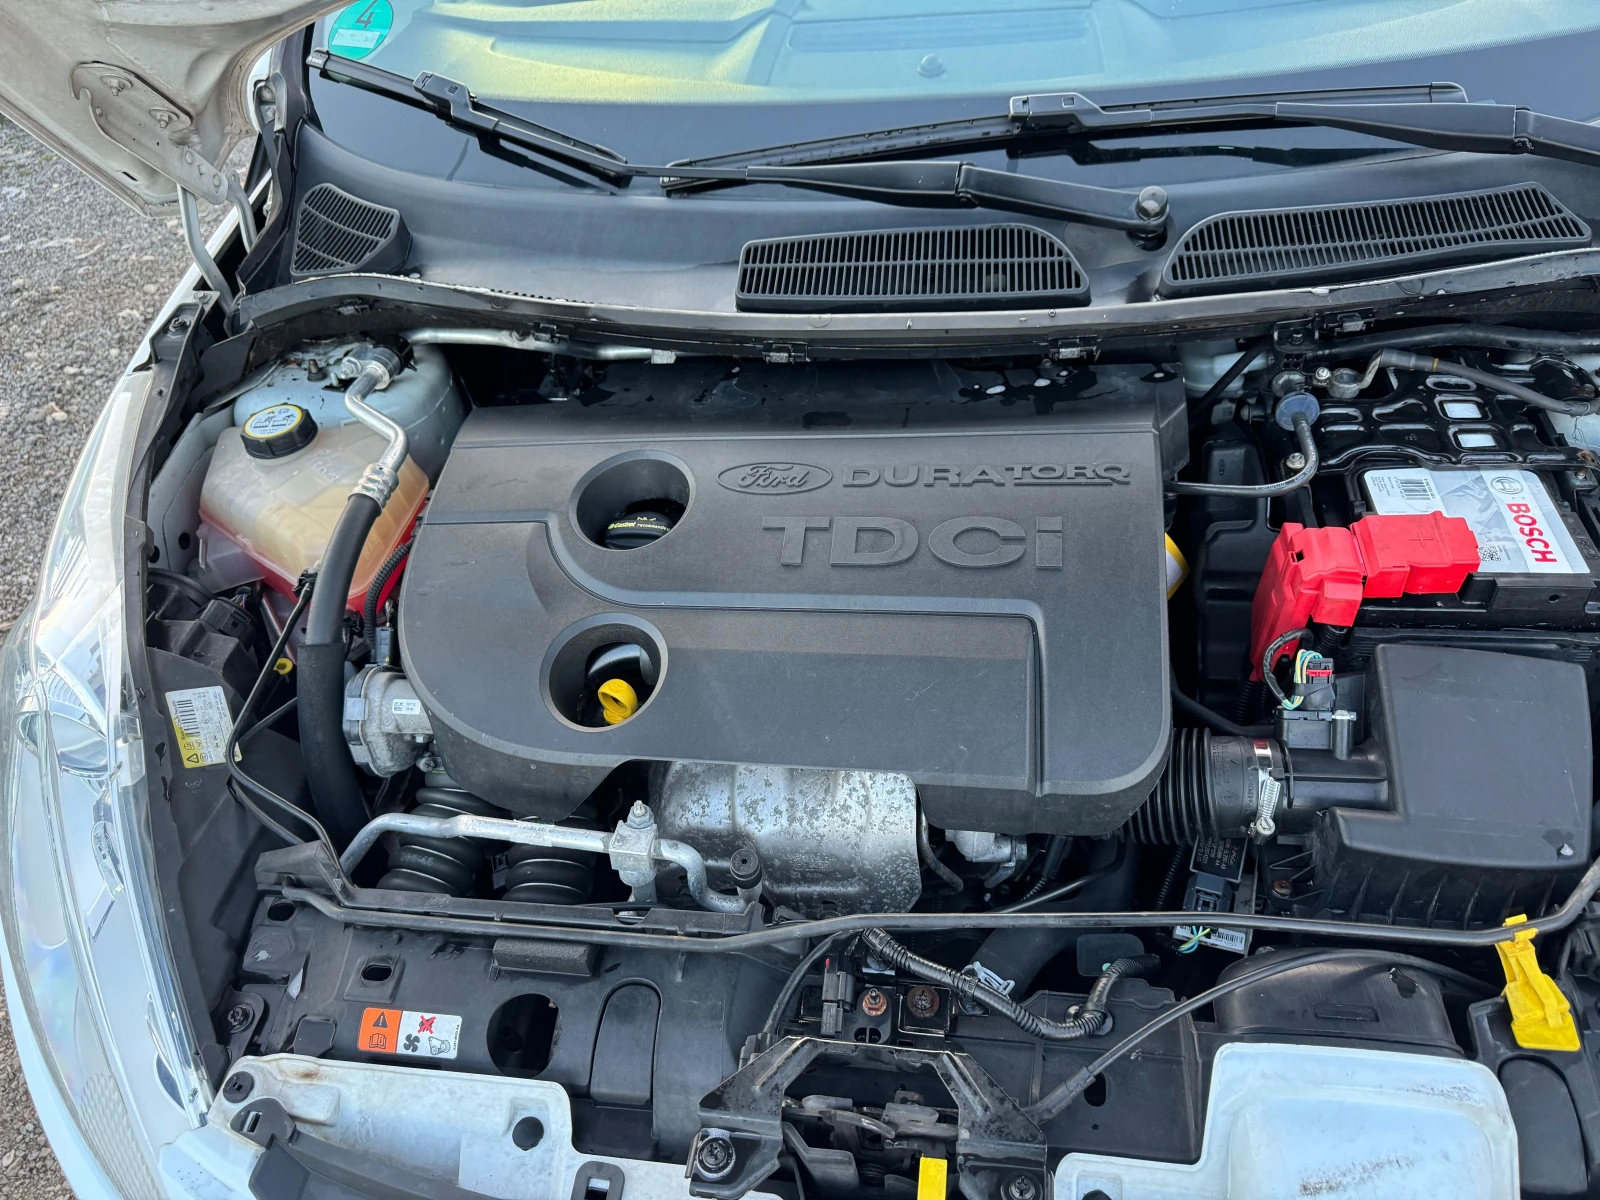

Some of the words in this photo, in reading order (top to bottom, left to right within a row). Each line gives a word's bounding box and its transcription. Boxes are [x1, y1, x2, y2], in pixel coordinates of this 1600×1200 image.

[355, 0, 379, 29] 4
[737, 465, 811, 488] Ford
[842, 462, 1131, 487] DURATORQ
[614, 521, 637, 529] Castrol
[1506, 502, 1558, 562] BOSCH
[762, 515, 1063, 569] TDCi
